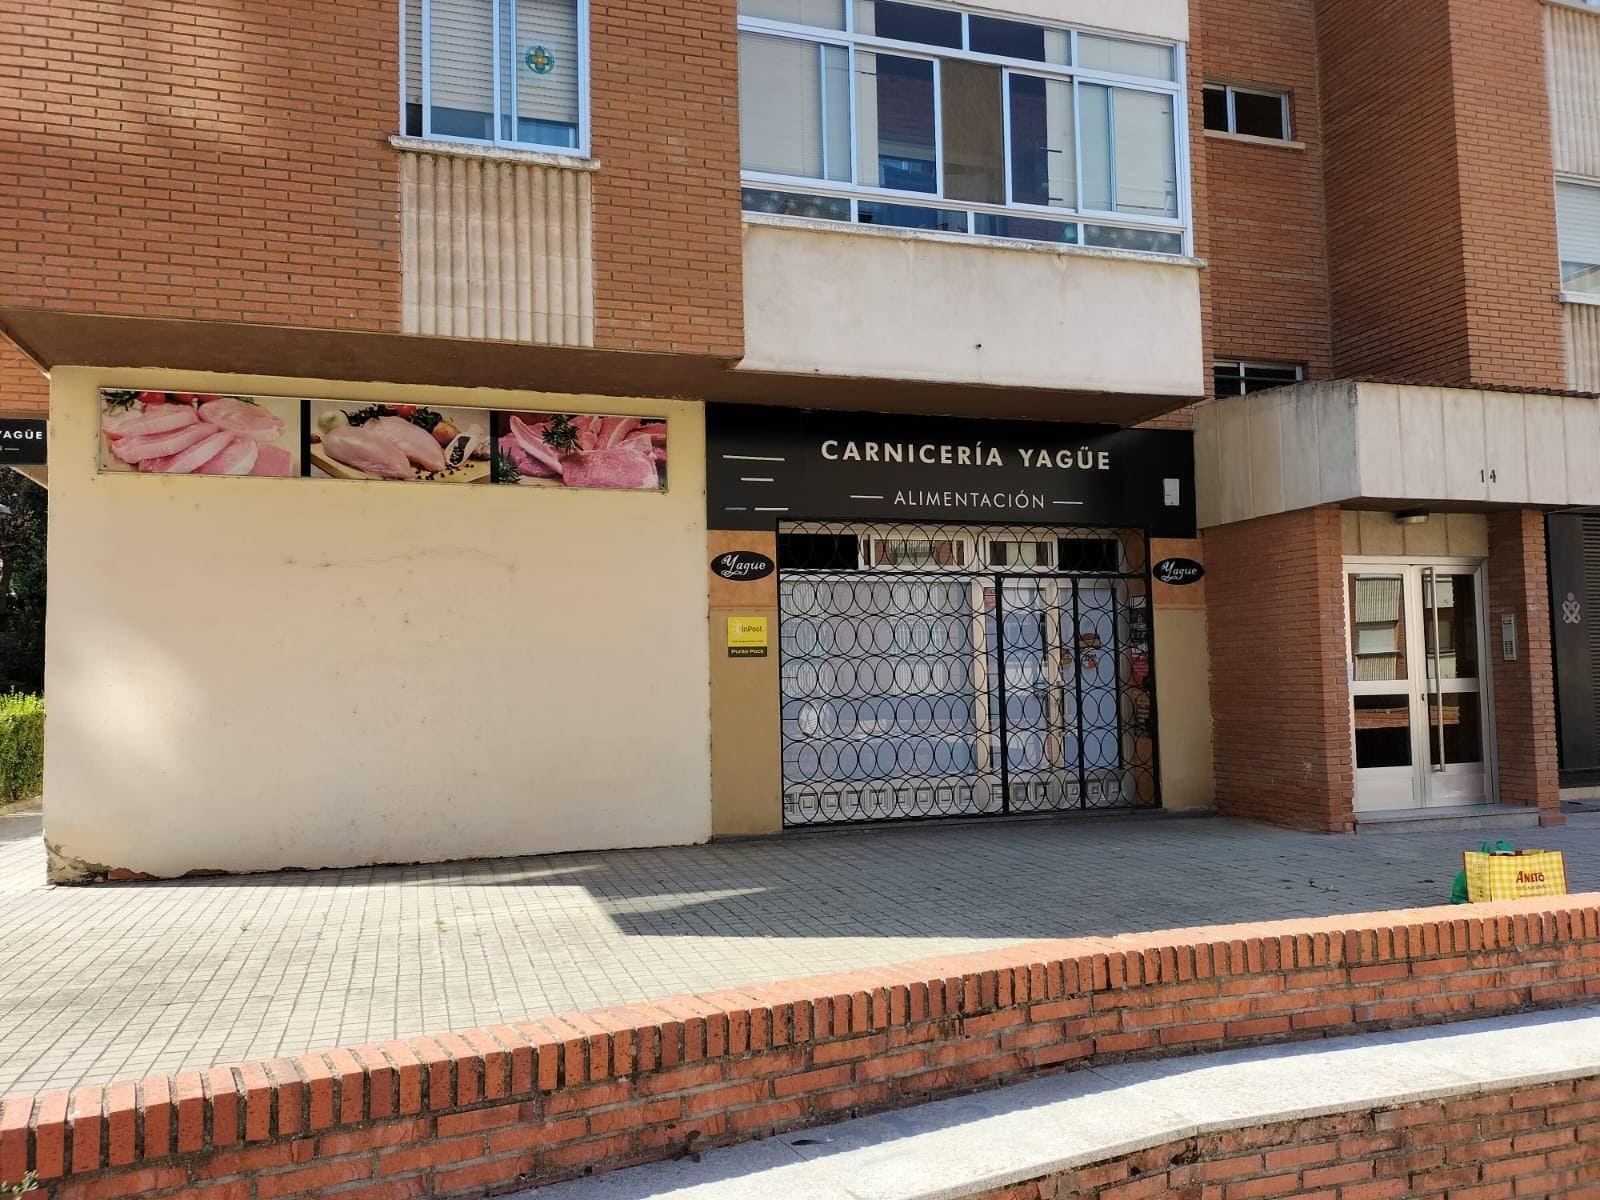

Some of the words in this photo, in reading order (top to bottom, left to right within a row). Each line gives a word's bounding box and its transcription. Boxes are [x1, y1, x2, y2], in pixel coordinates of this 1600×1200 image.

[0, 428, 43, 440] AGÜE
[820, 439, 1003, 467] CARNICERÍA
[1018, 446, 1110, 470] YAGÜE
[1480, 469, 1497, 483] 14
[893, 489, 1044, 509] ALIMENTACIÓN
[741, 625, 762, 633] InPost
